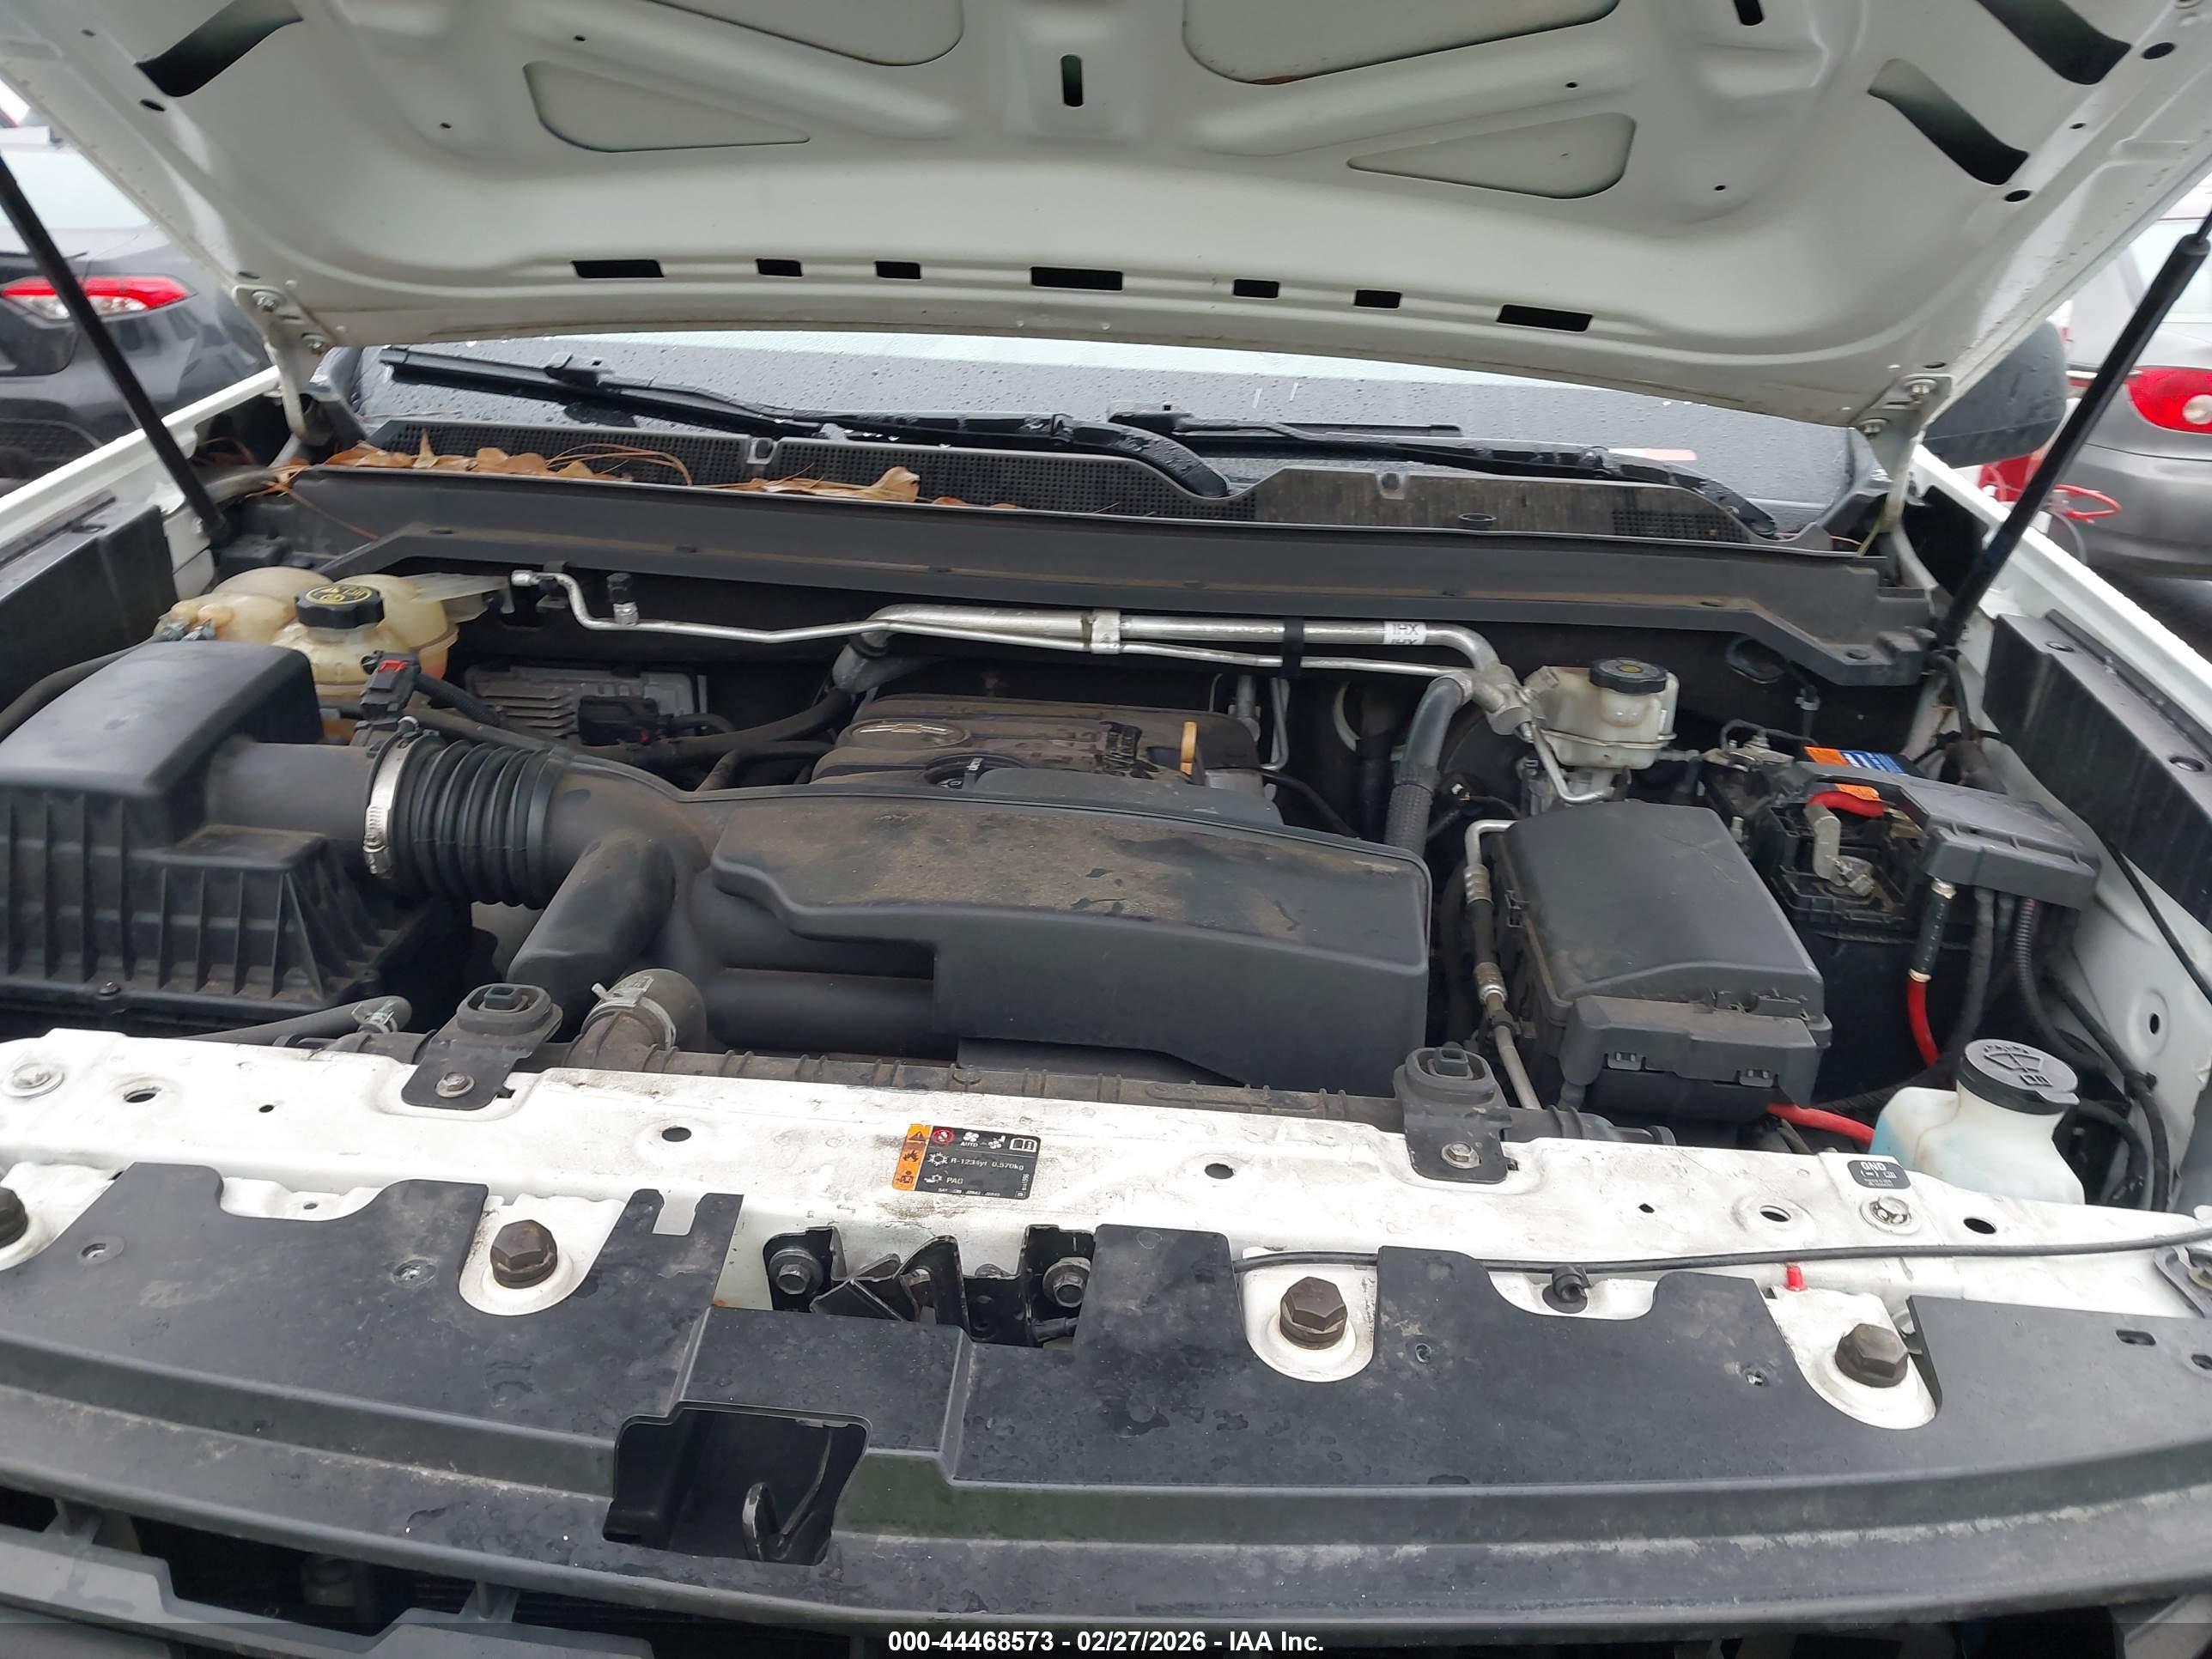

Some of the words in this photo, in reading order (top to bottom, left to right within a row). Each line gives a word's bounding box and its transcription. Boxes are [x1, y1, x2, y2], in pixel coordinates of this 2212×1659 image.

[950, 1157, 988, 1168] R-1234yf
[991, 1161, 1024, 1171] 0.570kg
[1860, 1161, 1887, 1171] GND
[946, 1176, 963, 1185] PAG
